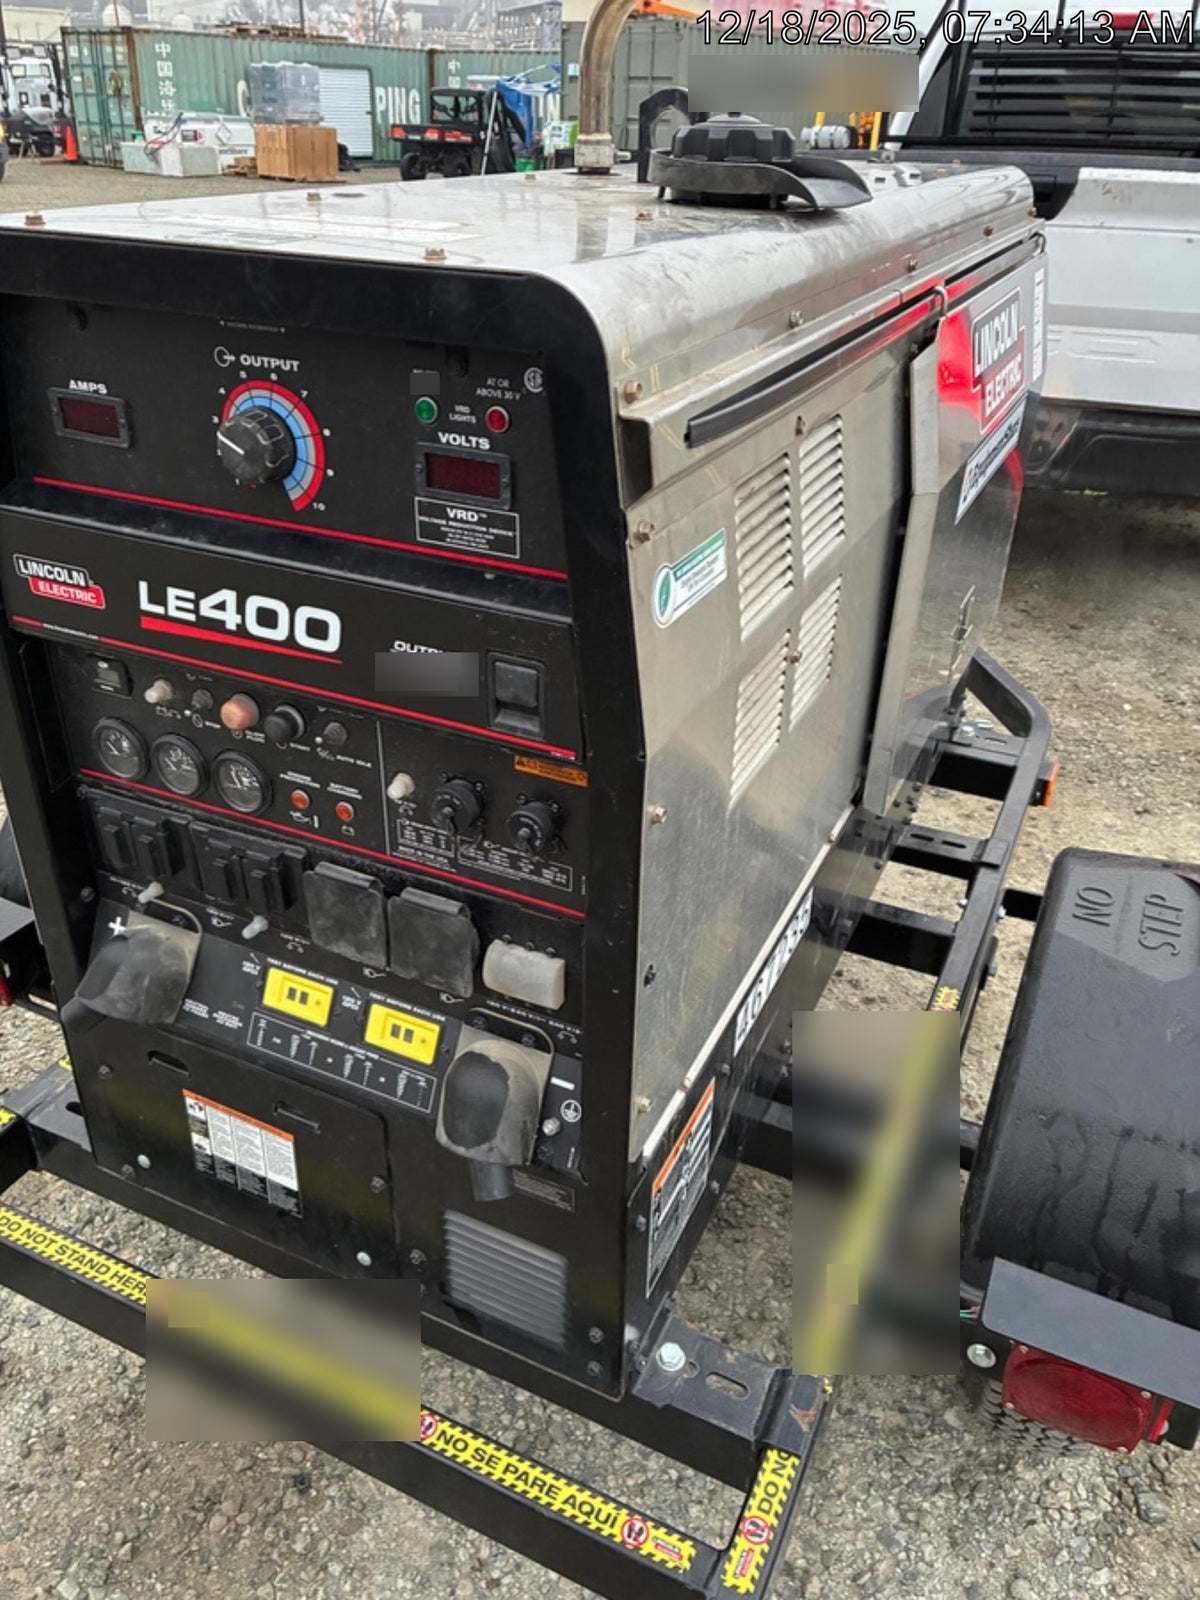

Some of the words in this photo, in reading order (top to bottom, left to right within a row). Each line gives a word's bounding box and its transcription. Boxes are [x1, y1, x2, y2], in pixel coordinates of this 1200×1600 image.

[974, 300, 1019, 379] LINCOLN
[239, 354, 300, 372] OUTPUT
[239, 371, 248, 379] 5
[270, 373, 278, 381] 6
[486, 378, 497, 387] AT
[497, 379, 510, 388] OR
[68, 379, 108, 395] AMPS
[218, 387, 226, 395] 4
[300, 390, 308, 398] 7
[475, 387, 502, 399] ABOVE
[449, 413, 477, 424] LIGHTS
[454, 405, 471, 414] VRD
[438, 431, 491, 451] VOLTS
[18, 559, 87, 587] LINCOLN
[38, 581, 97, 603] ELECTRIC
[138, 580, 342, 654] LE400
[1072, 886, 1115, 928] NO
[1138, 893, 1185, 957] STEP
[0, 1215, 22, 1232] DO
[20, 1228, 58, 1249] NOT
[55, 1241, 109, 1275] STAND
[109, 1270, 146, 1296] HER
[436, 1429, 469, 1454] NO
[470, 1446, 499, 1469] SE
[502, 1462, 562, 1502] PARE
[757, 1480, 779, 1515] DO
[770, 1450, 793, 1478] NO
